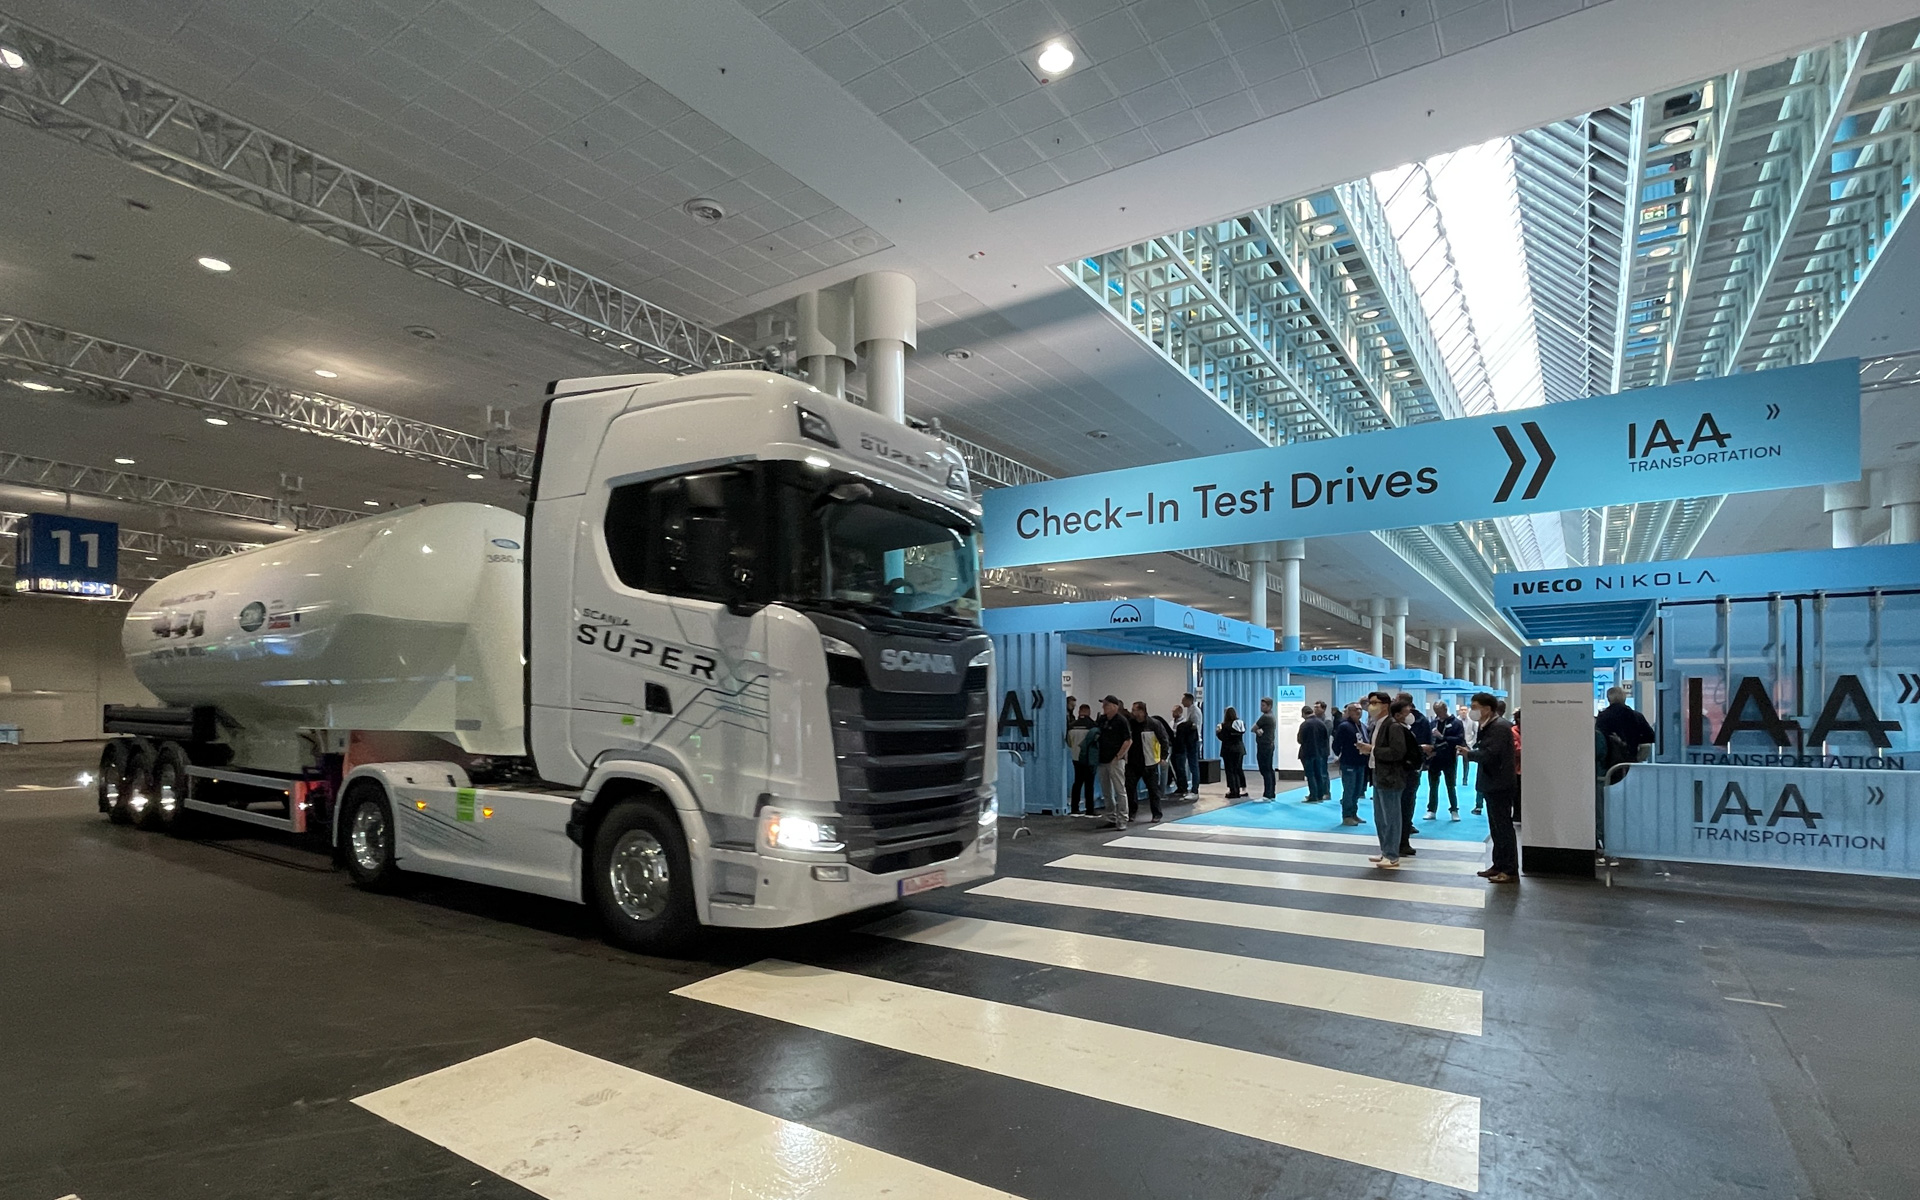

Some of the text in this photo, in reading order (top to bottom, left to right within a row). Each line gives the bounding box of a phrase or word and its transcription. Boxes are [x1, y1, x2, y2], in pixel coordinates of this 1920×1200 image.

[1628, 412, 1732, 459] IAA
[1628, 445, 1781, 473] TRANSPORTATION
[1016, 465, 1438, 540] Check-In Test Drives
[50, 529, 99, 568] 11
[1513, 570, 1716, 595] IVECO NIKOLA
[582, 608, 631, 626] SCANIA
[576, 623, 717, 680] SUPER
[880, 648, 957, 675] SCANIA
[1311, 654, 1340, 662] BOSCH
[1528, 653, 1568, 670] IAA
[1638, 660, 1653, 669] TD
[1280, 689, 1295, 697] IAA
[1688, 674, 1903, 748] IAA
[1689, 752, 1905, 770] TRANSPORTATION
[1693, 780, 1825, 829] IAA
[1693, 826, 1886, 851] TRANSPORTATION
